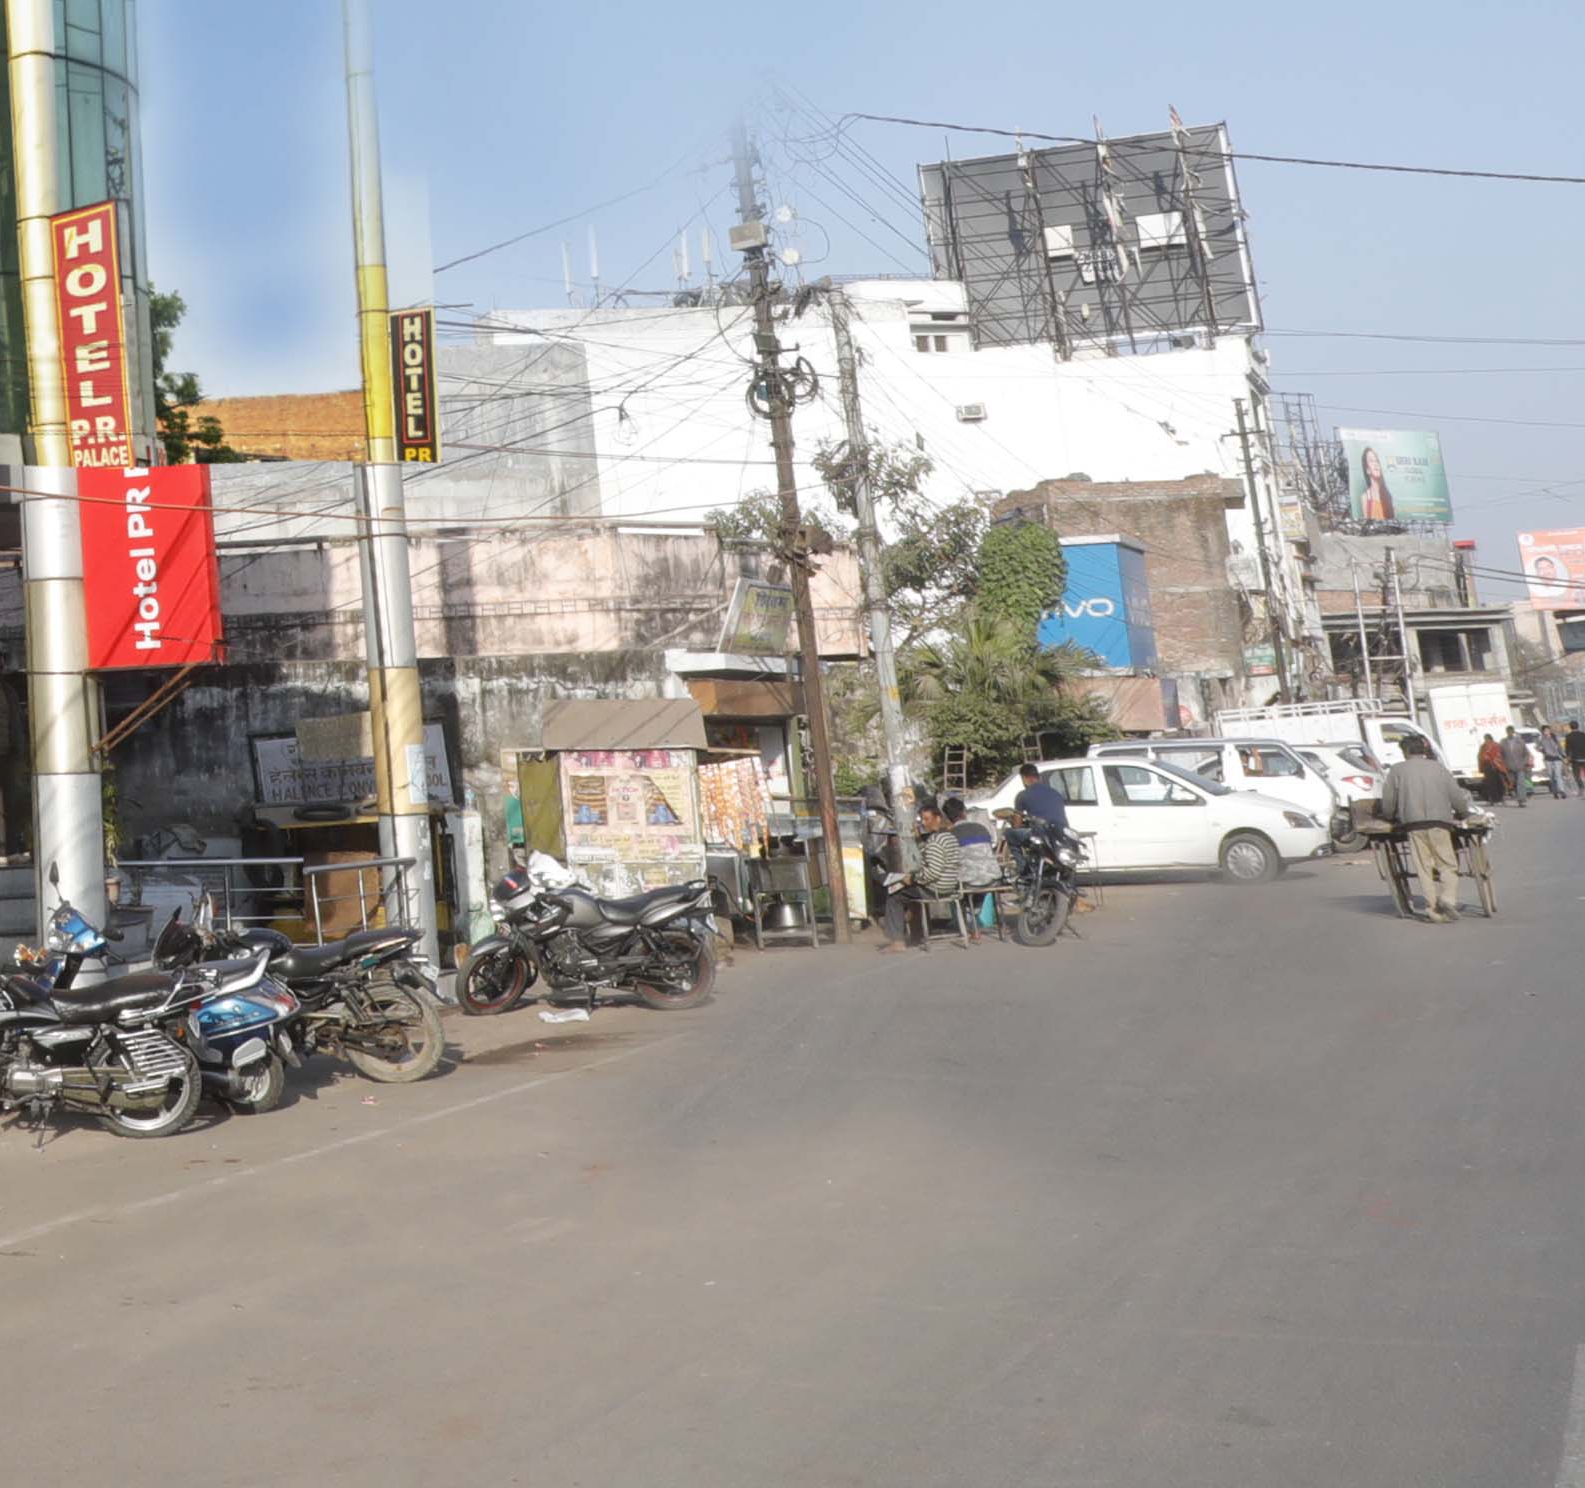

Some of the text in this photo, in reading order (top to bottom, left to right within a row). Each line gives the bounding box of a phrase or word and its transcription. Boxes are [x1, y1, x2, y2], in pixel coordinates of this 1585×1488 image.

[63, 218, 113, 408] HOTEL
[403, 316, 424, 438] HOTEL
[74, 445, 129, 467] PALACE
[404, 447, 432, 461] PR
[125, 485, 153, 539] PR
[129, 547, 162, 650] Hotel
